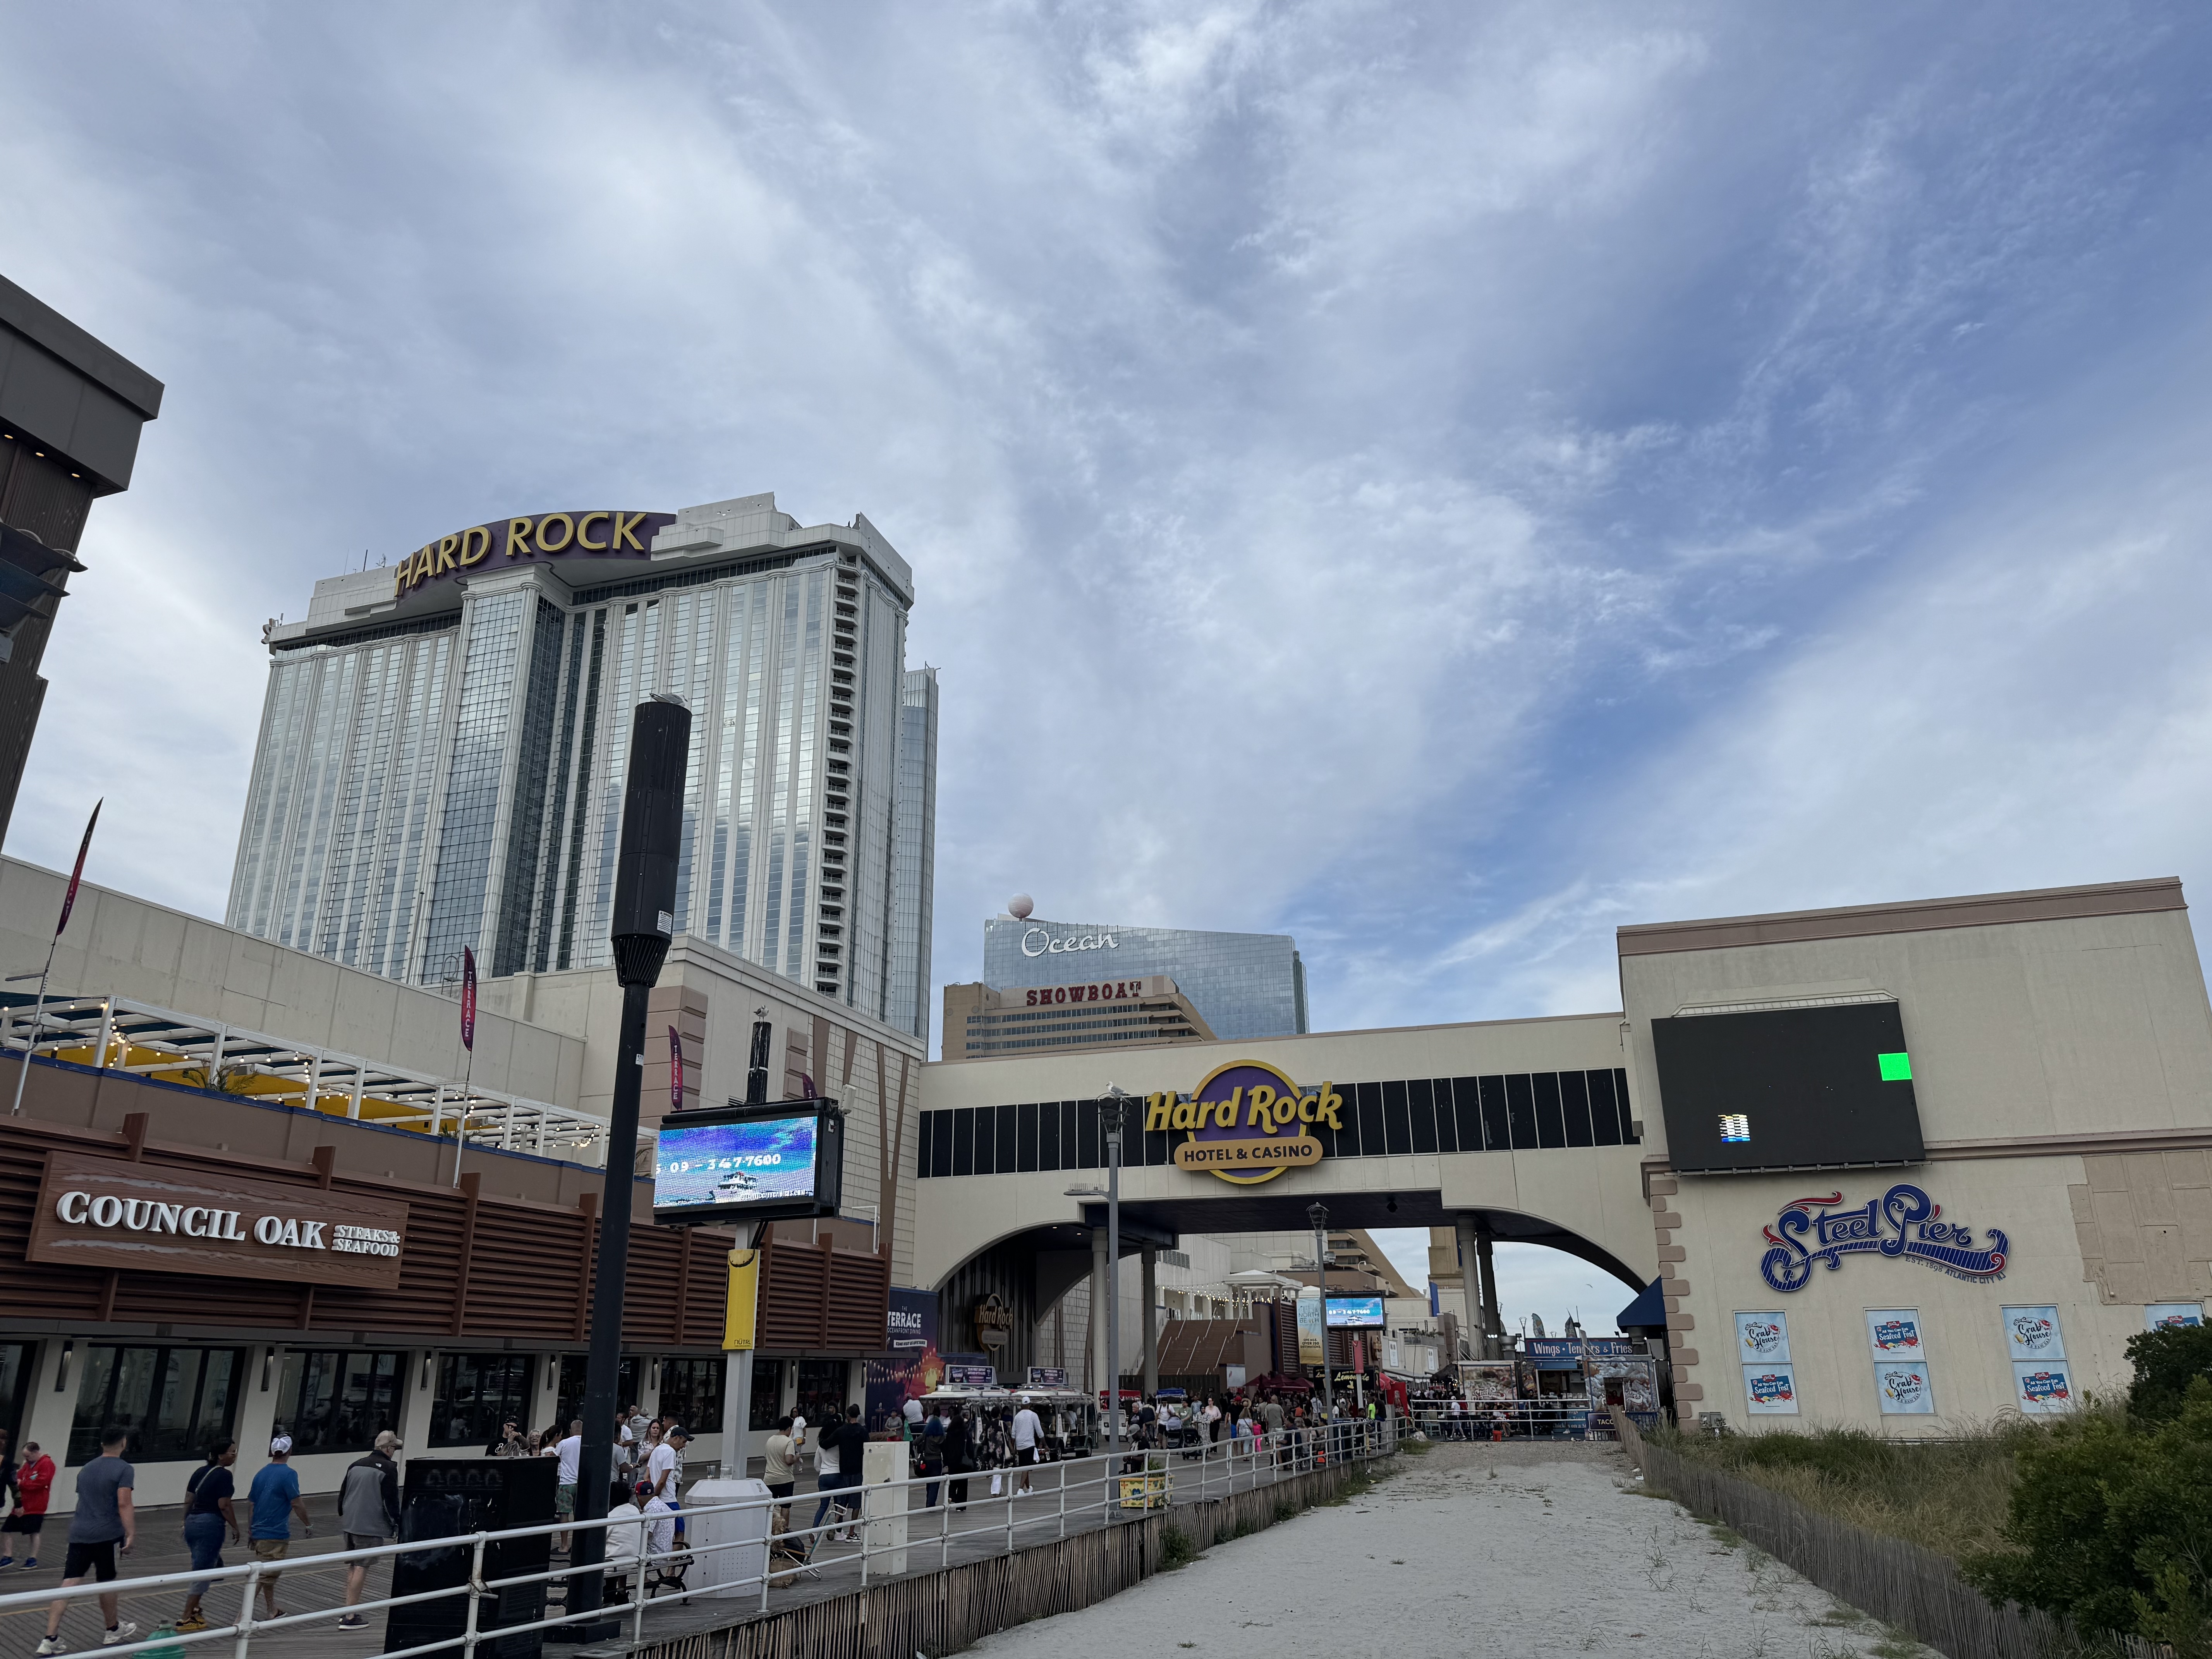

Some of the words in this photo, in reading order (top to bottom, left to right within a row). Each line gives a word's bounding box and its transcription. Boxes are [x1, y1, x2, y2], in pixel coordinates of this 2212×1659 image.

[394, 526, 492, 598] HARD
[505, 511, 648, 557] ROCK
[1021, 927, 1120, 957] Ocean
[1026, 981, 1142, 1006] SHOWBOAT
[465, 971, 473, 1037] TERRACE
[1145, 1085, 1243, 1131] Hard
[1247, 1081, 1343, 1134] Rock
[1184, 1148, 1233, 1162] HOTEL
[1237, 1148, 1248, 1160] &
[1252, 1144, 1313, 1159] CASINO
[56, 1191, 247, 1242] COUNCIL
[254, 1216, 326, 1249] OAK
[1760, 1192, 1884, 1291] Steel
[1878, 1183, 1972, 1257] Pier
[331, 1238, 399, 1257] SEAFOOD
[1905, 1255, 1923, 1266] EST.
[1925, 1262, 1943, 1272] 1898
[1944, 1268, 1977, 1283] ATLANTIC
[1979, 1276, 1995, 1284] CITY
[1996, 1271, 2006, 1281] NJ
[887, 1311, 921, 1328] TERRACE
[979, 1304, 997, 1324] Hard
[997, 1306, 1013, 1329] Rock
[1749, 1327, 1771, 1339] Crab
[1879, 1331, 1901, 1341] Seafood
[2018, 1322, 2042, 1335] Crab
[1753, 1336, 1779, 1349] House
[2023, 1332, 2051, 1346] House
[1533, 1342, 1560, 1357] Wings
[1566, 1342, 1600, 1354] Tenrs
[1611, 1342, 1632, 1355] Fries
[1334, 1372, 1369, 1382] Lemonde
[1889, 1377, 1912, 1389] Crab
[1755, 1385, 1776, 1394] Seafood
[1894, 1386, 1920, 1400] House
[2027, 1383, 2051, 1392] Seafood
[2052, 1382, 2065, 1390] Fest
